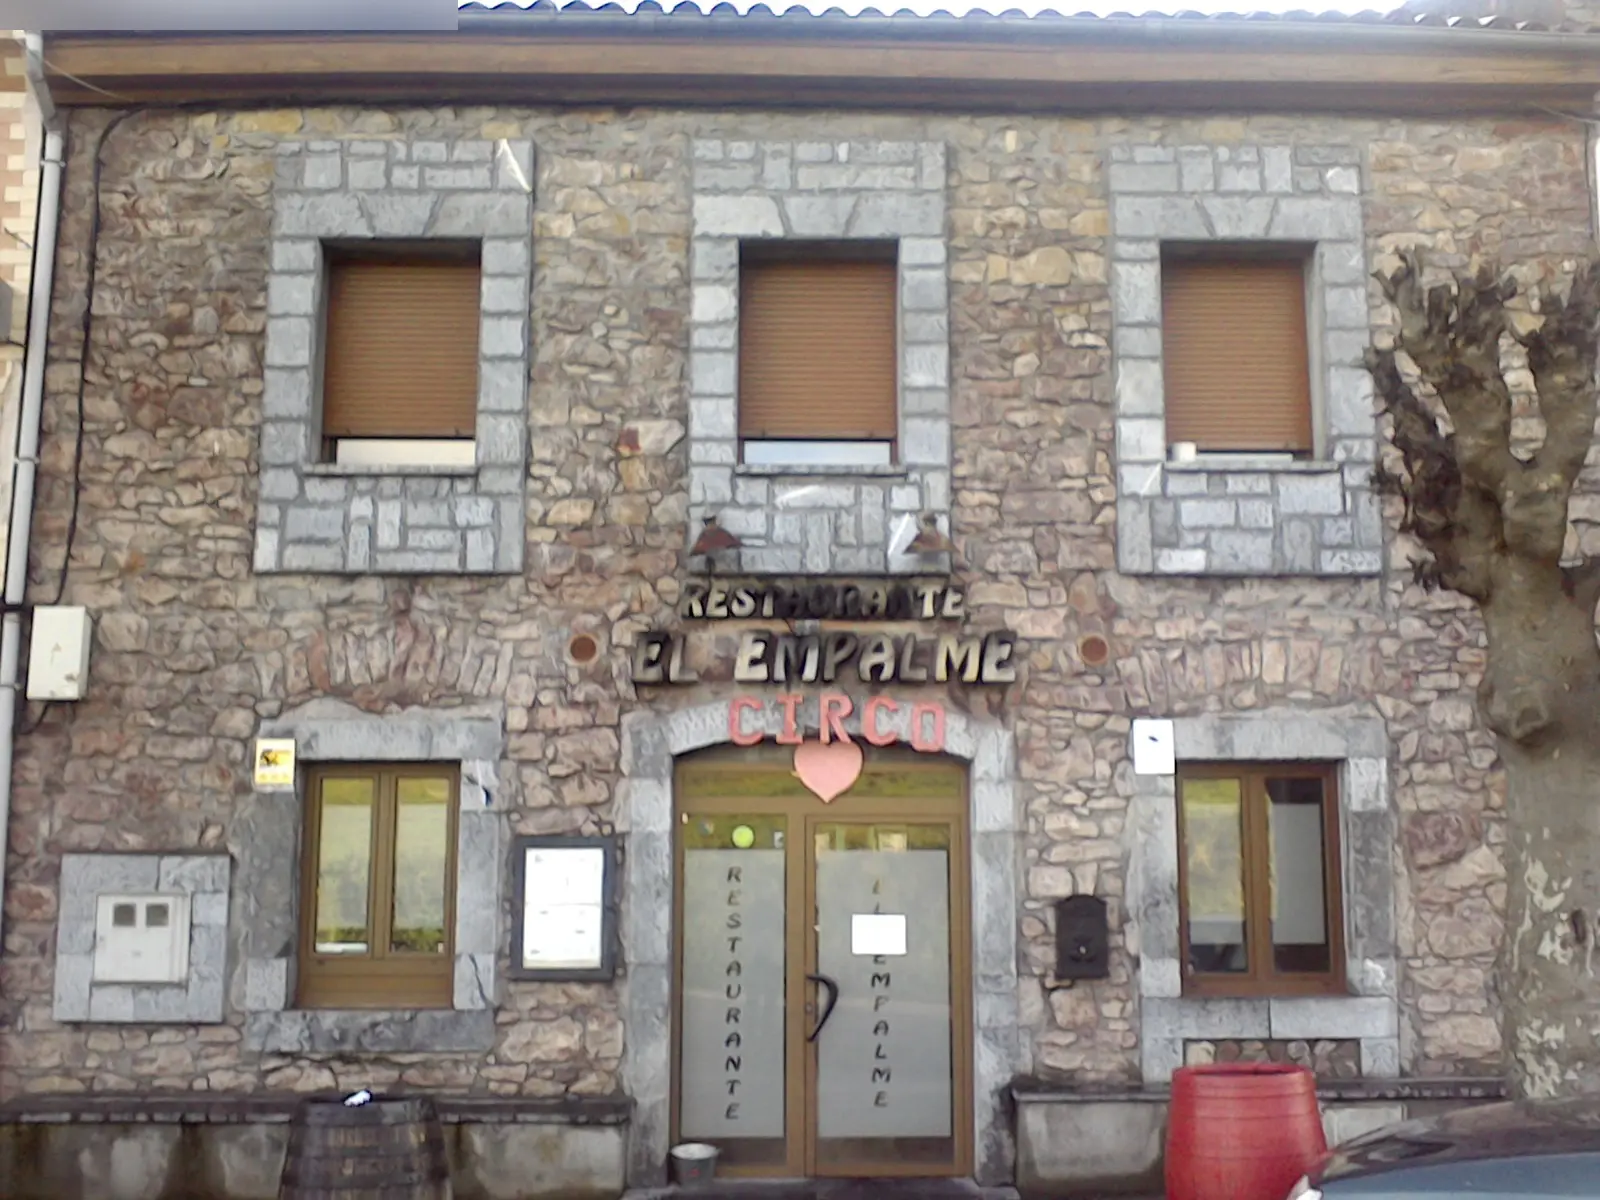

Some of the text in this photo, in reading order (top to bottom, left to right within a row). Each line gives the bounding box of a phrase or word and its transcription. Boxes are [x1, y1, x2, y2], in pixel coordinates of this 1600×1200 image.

[682, 580, 966, 618] RESTAURANTE
[632, 630, 1018, 683] EL EMPALME
[727, 693, 947, 753] CIRCO
[724, 865, 742, 1121] RESTAURANTE
